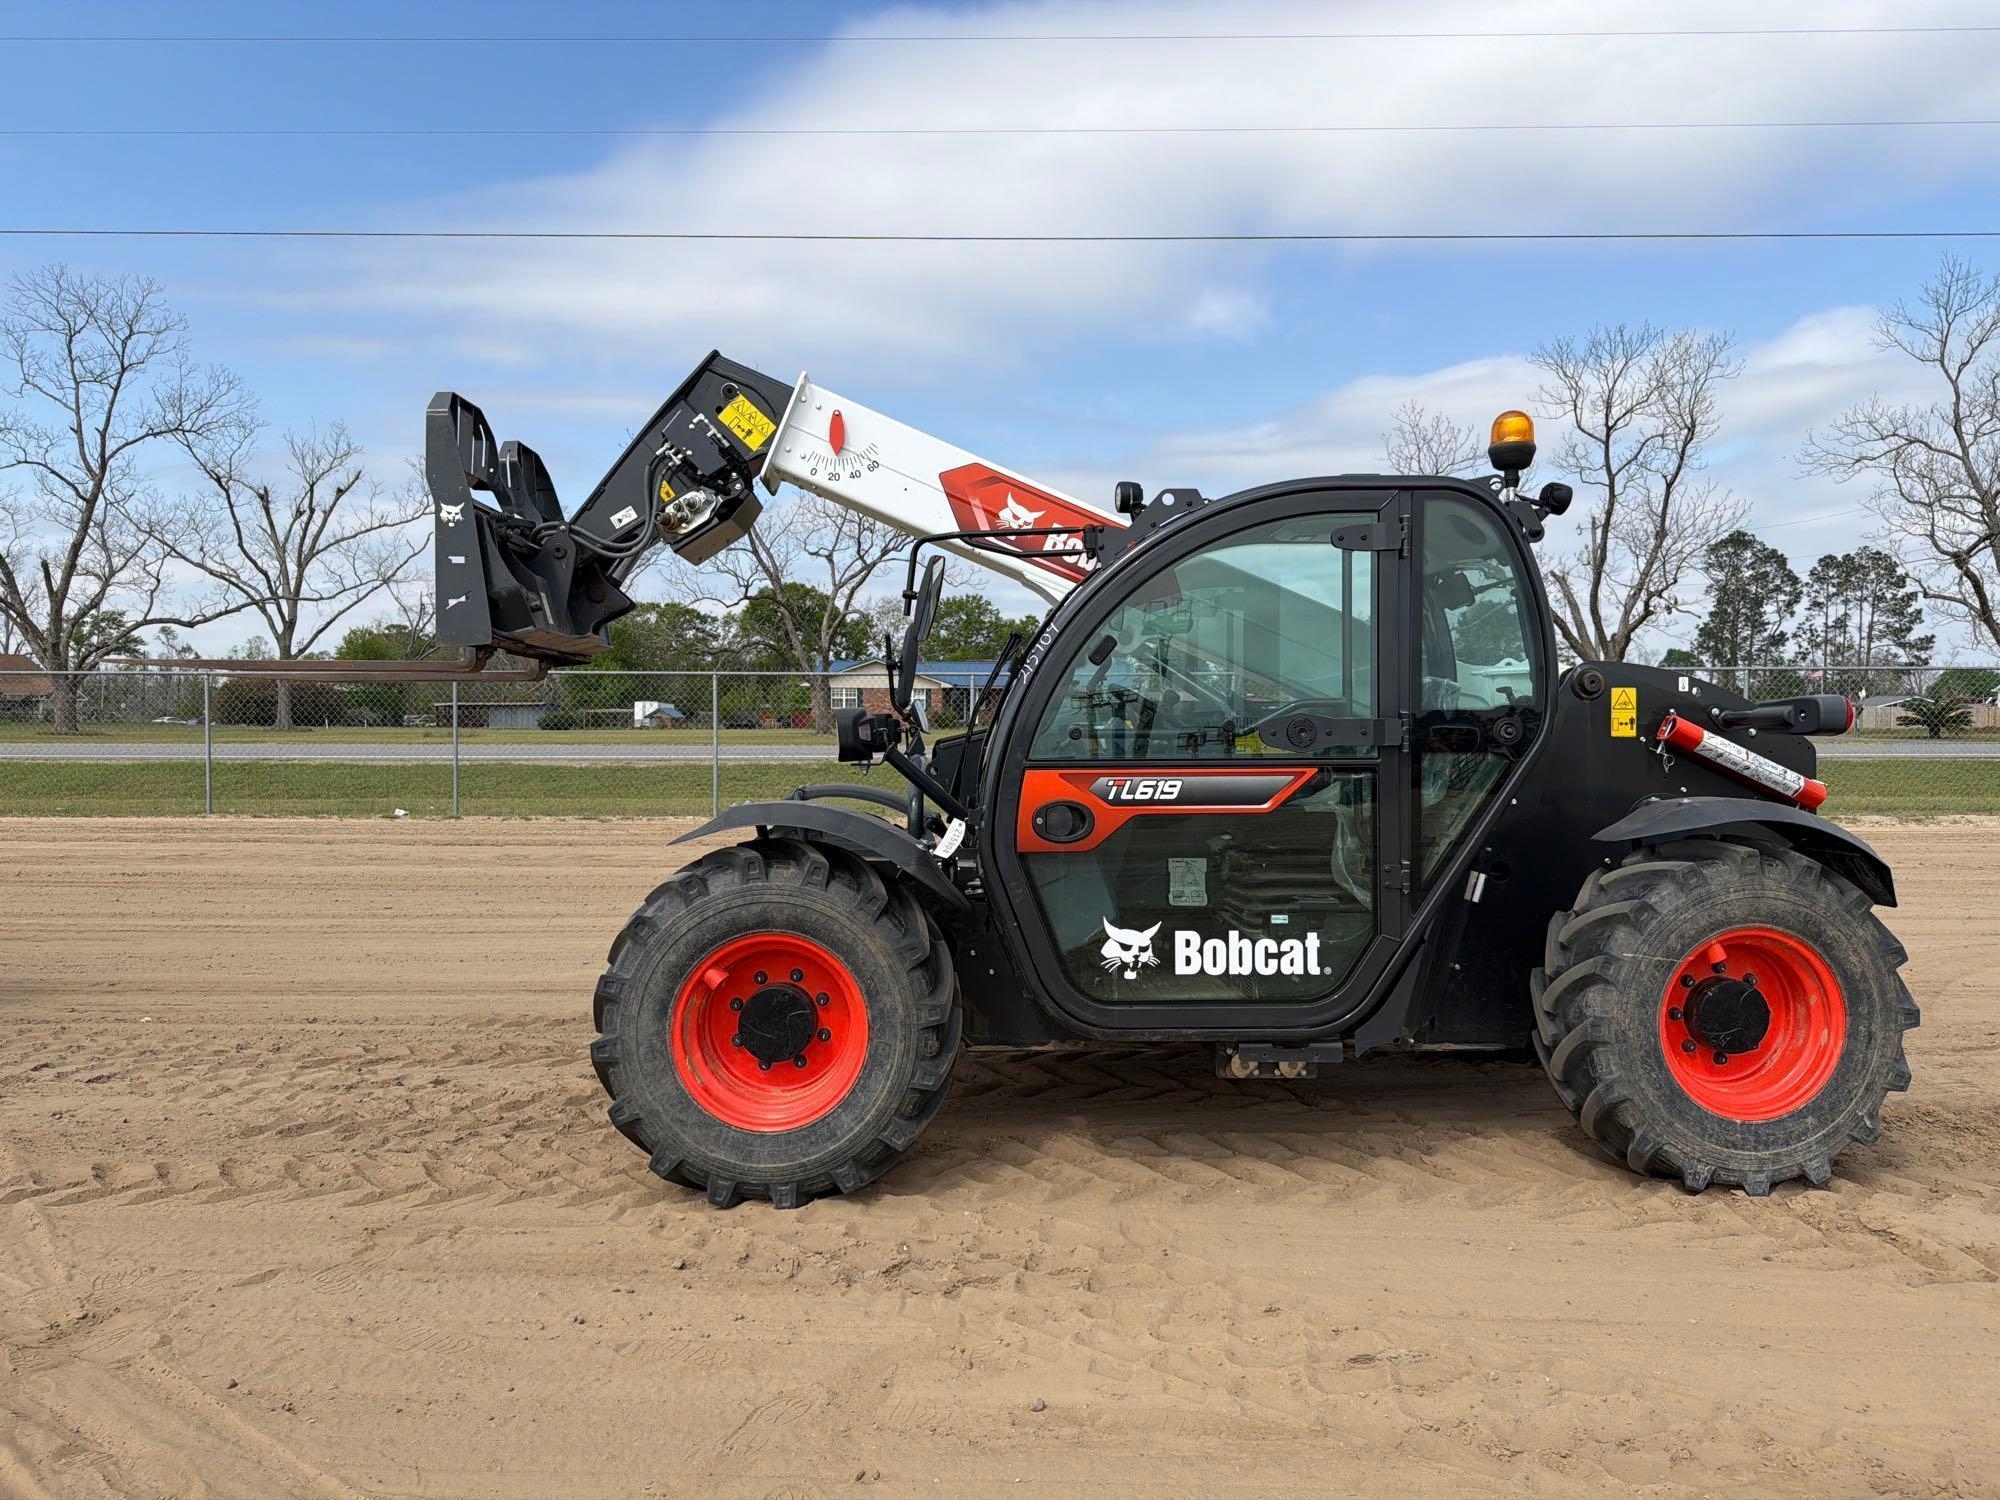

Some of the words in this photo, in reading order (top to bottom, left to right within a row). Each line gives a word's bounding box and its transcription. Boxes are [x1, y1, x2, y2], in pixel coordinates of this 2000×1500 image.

[810, 467, 818, 476] 0
[828, 472, 841, 481] 20
[849, 469, 862, 480] 40
[867, 460, 880, 472] 60
[1106, 779, 1184, 801] TL619
[1175, 931, 1321, 975] Bobcat
